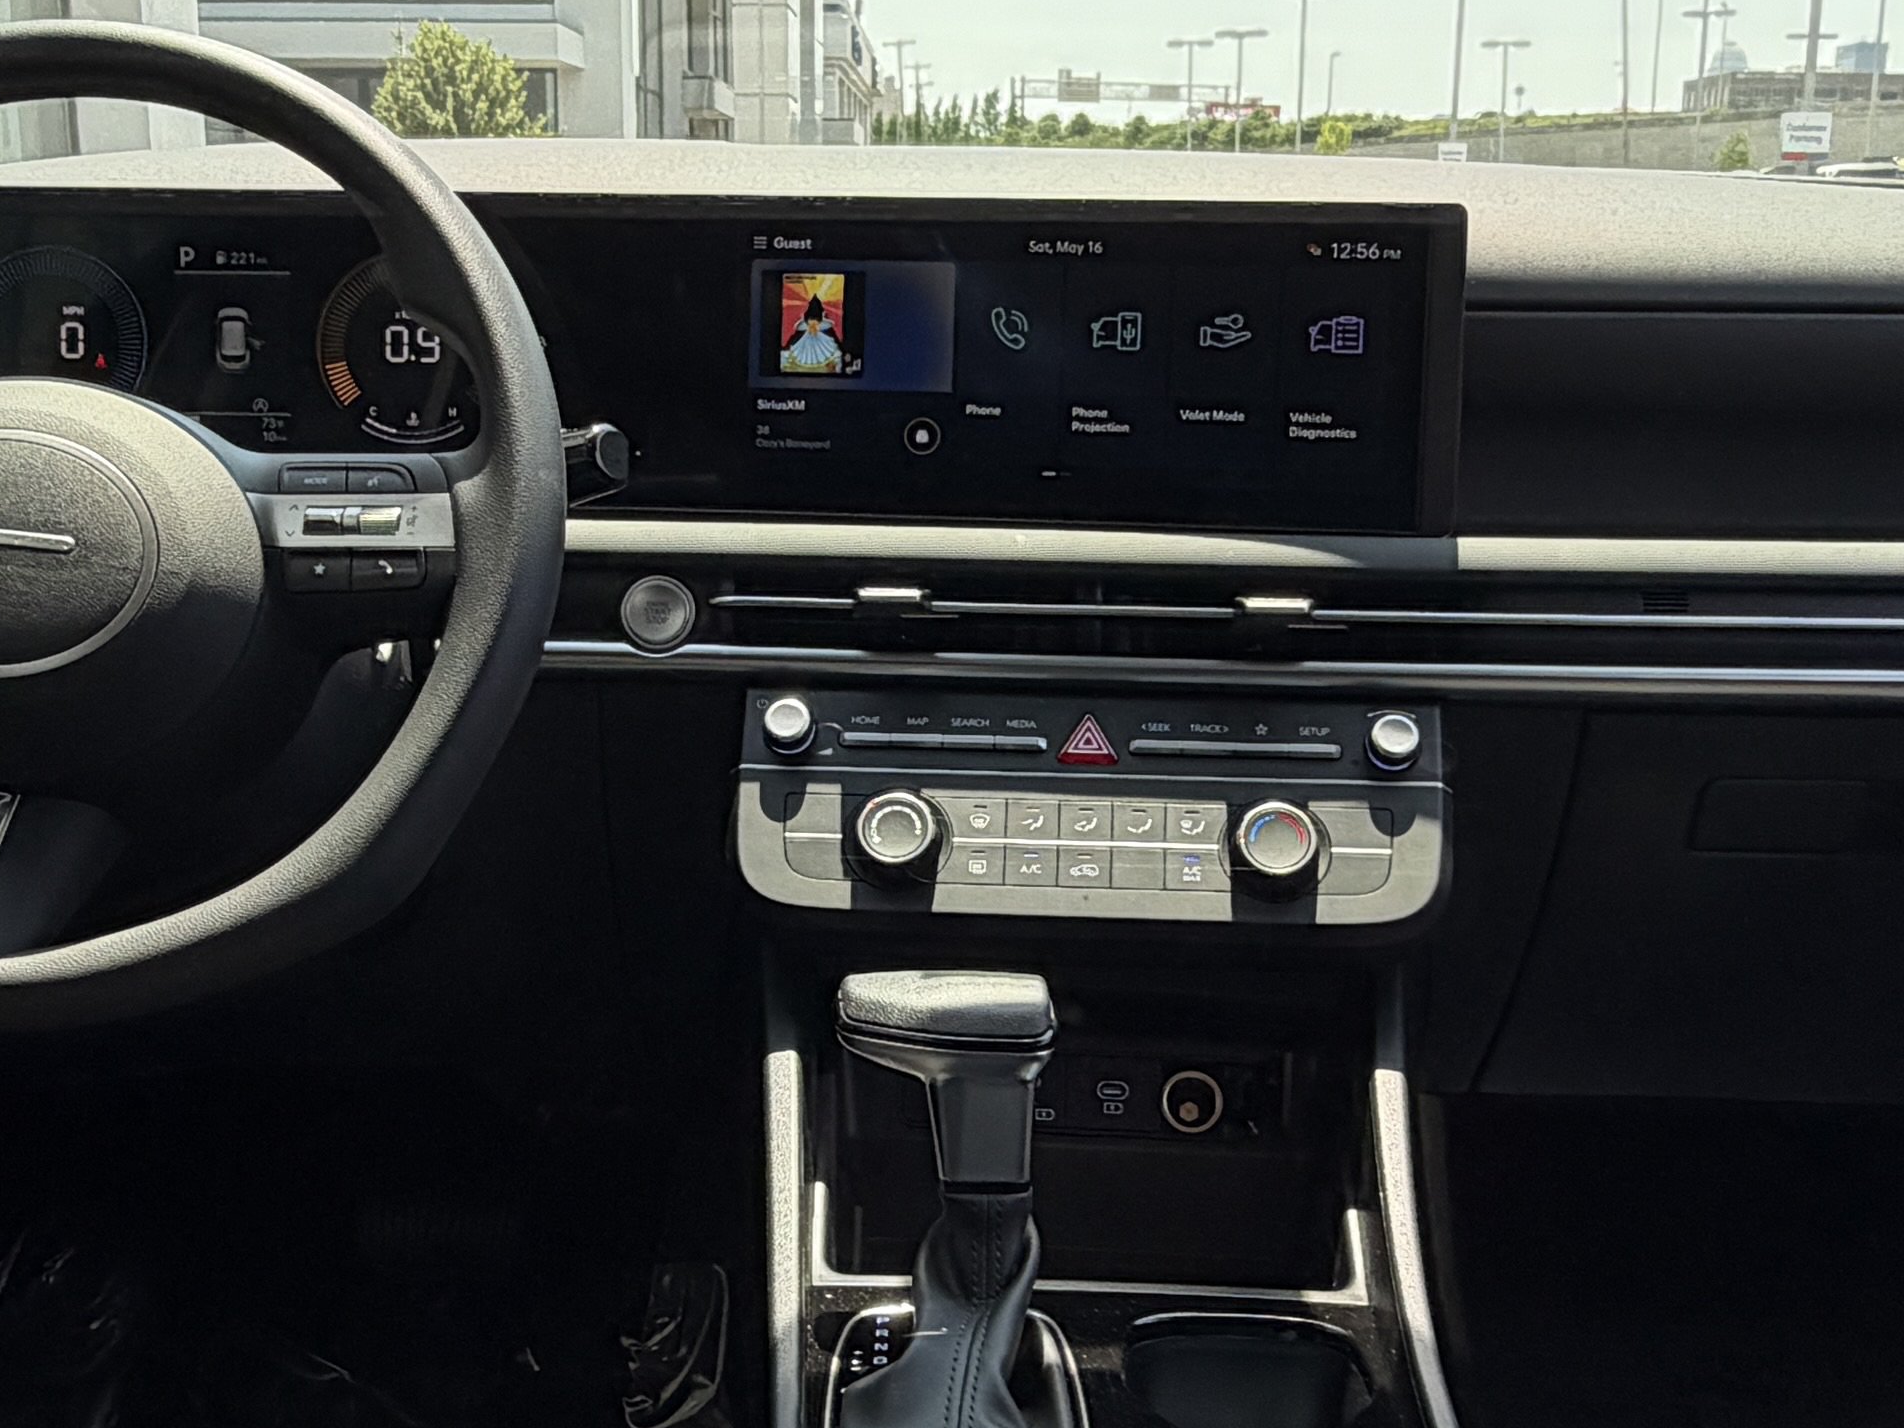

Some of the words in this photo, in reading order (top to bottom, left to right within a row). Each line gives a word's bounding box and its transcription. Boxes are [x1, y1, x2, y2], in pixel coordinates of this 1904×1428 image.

[773, 236, 812, 250] Guest
[1028, 240, 1053, 255] Sat,
[1056, 241, 1084, 256] May
[1087, 241, 1103, 254] 16
[179, 246, 195, 268] P
[1330, 243, 1380, 260] 12:56
[60, 322, 84, 359] 0
[757, 399, 805, 411] SiriusXM
[965, 404, 1002, 417] Phone
[1072, 407, 1108, 418] Phone
[1179, 409, 1210, 421] Valet
[1212, 410, 1245, 422] Mode
[1289, 413, 1332, 424] Vehicle
[1072, 421, 1130, 433] Projection
[1289, 426, 1357, 440] Diagnostics
[851, 716, 881, 725] HOME
[907, 717, 930, 726] MAP
[951, 717, 990, 728] SEARCH
[1006, 719, 1037, 729] MEDIA
[1299, 726, 1331, 737] SETUP
[1020, 864, 1043, 875] A/C
